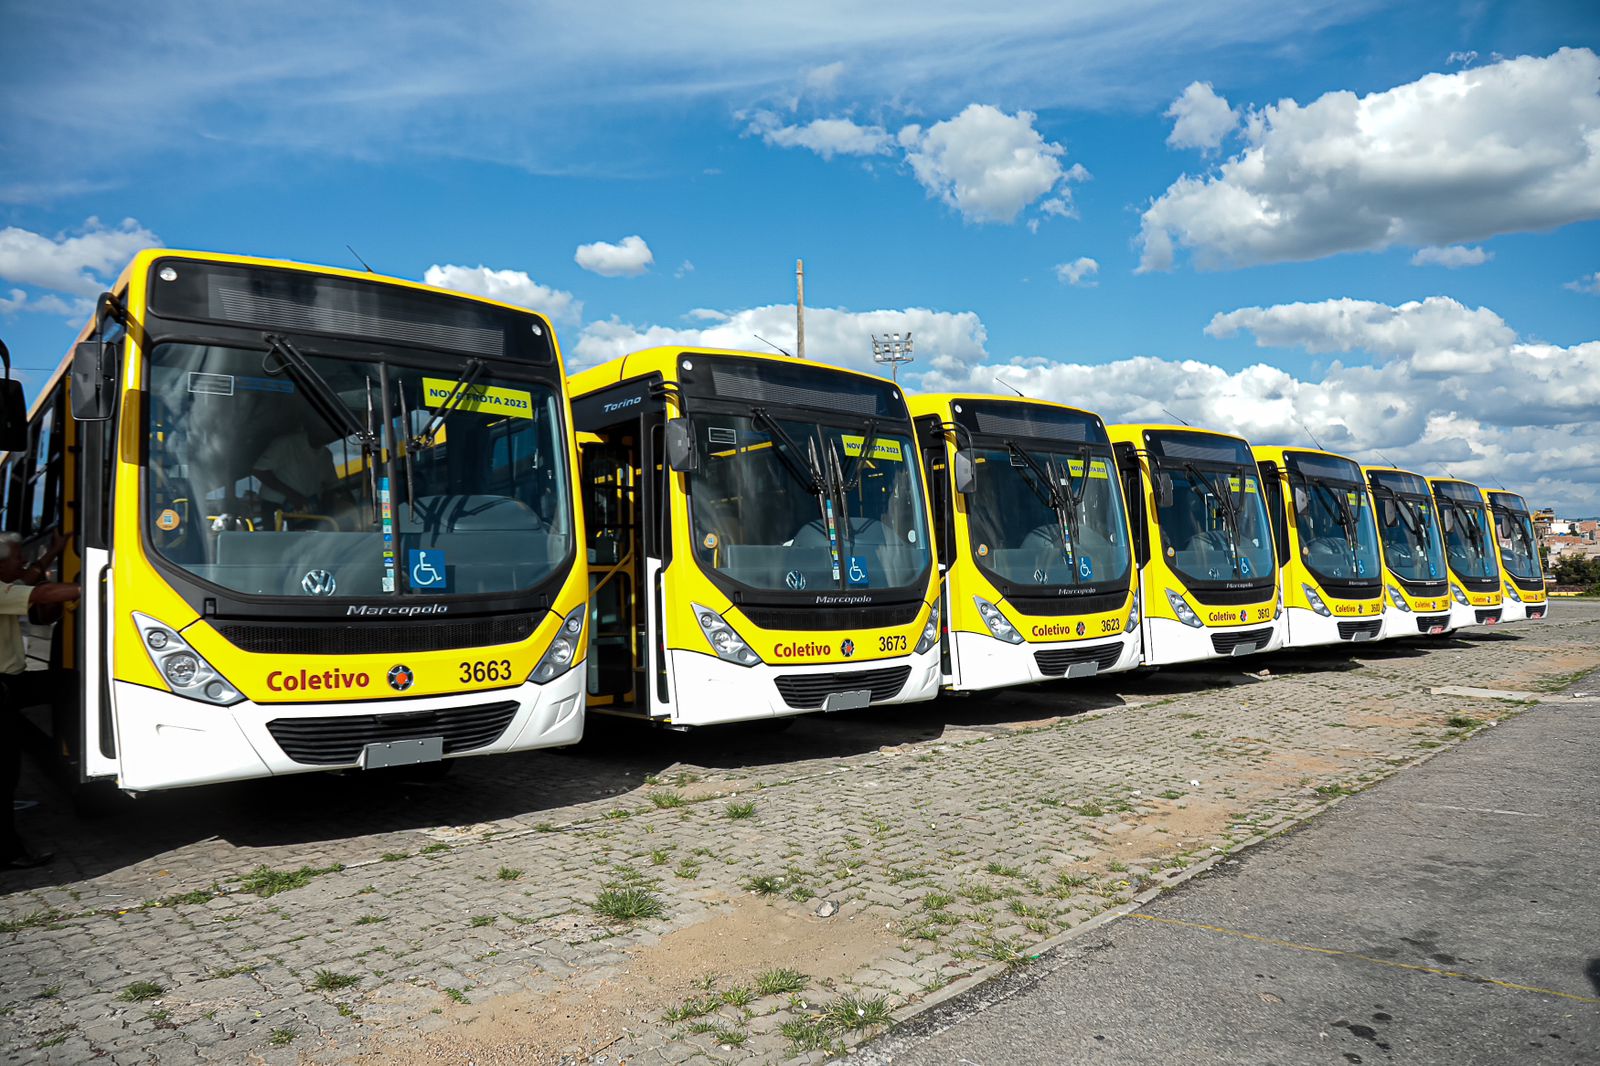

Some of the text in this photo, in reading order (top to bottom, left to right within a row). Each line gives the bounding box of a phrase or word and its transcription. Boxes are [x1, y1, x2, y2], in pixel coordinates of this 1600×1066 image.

[504, 398, 528, 409] 2023
[604, 396, 642, 413] Torino
[815, 595, 872, 604] Marcopolo
[346, 603, 448, 617] Marcopolo
[1335, 604, 1356, 613] Coletivo
[1208, 611, 1236, 621] Coletivo
[1032, 617, 1120, 636] Coletivo 3623
[774, 635, 907, 657] Coletivo 3673
[266, 659, 512, 692] Coletivo 3663
